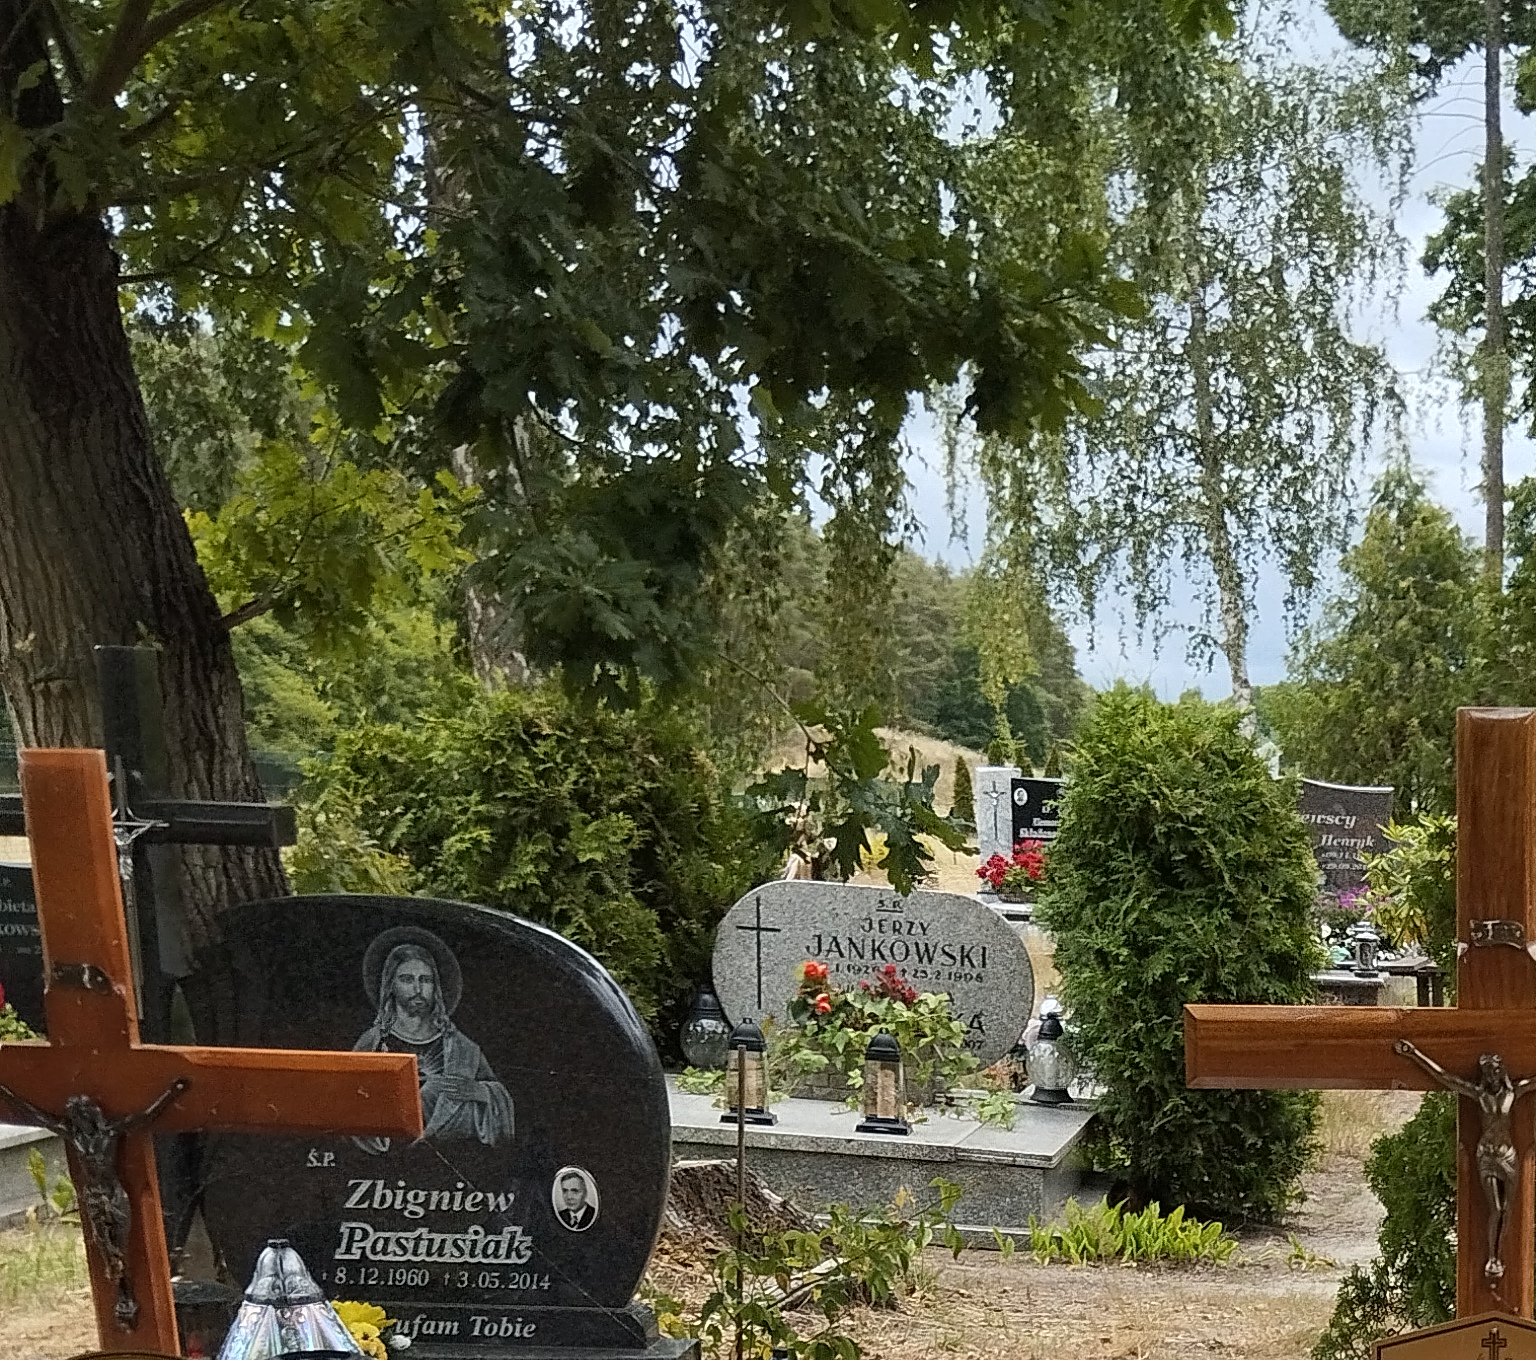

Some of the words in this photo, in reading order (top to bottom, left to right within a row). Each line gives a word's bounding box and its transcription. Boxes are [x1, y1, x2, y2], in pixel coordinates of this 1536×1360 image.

[1320, 834, 1375, 850] Henryk
[861, 917, 931, 936] JERZY
[804, 934, 988, 969] JANKOWSKI
[343, 1179, 516, 1219] Zbigniew
[334, 1222, 534, 1264] Pastusiak
[333, 1266, 430, 1287] 8.12.1960
[456, 1271, 552, 1291] 3.05.2014
[395, 1314, 461, 1340] ufam
[469, 1315, 538, 1339] Tobie
